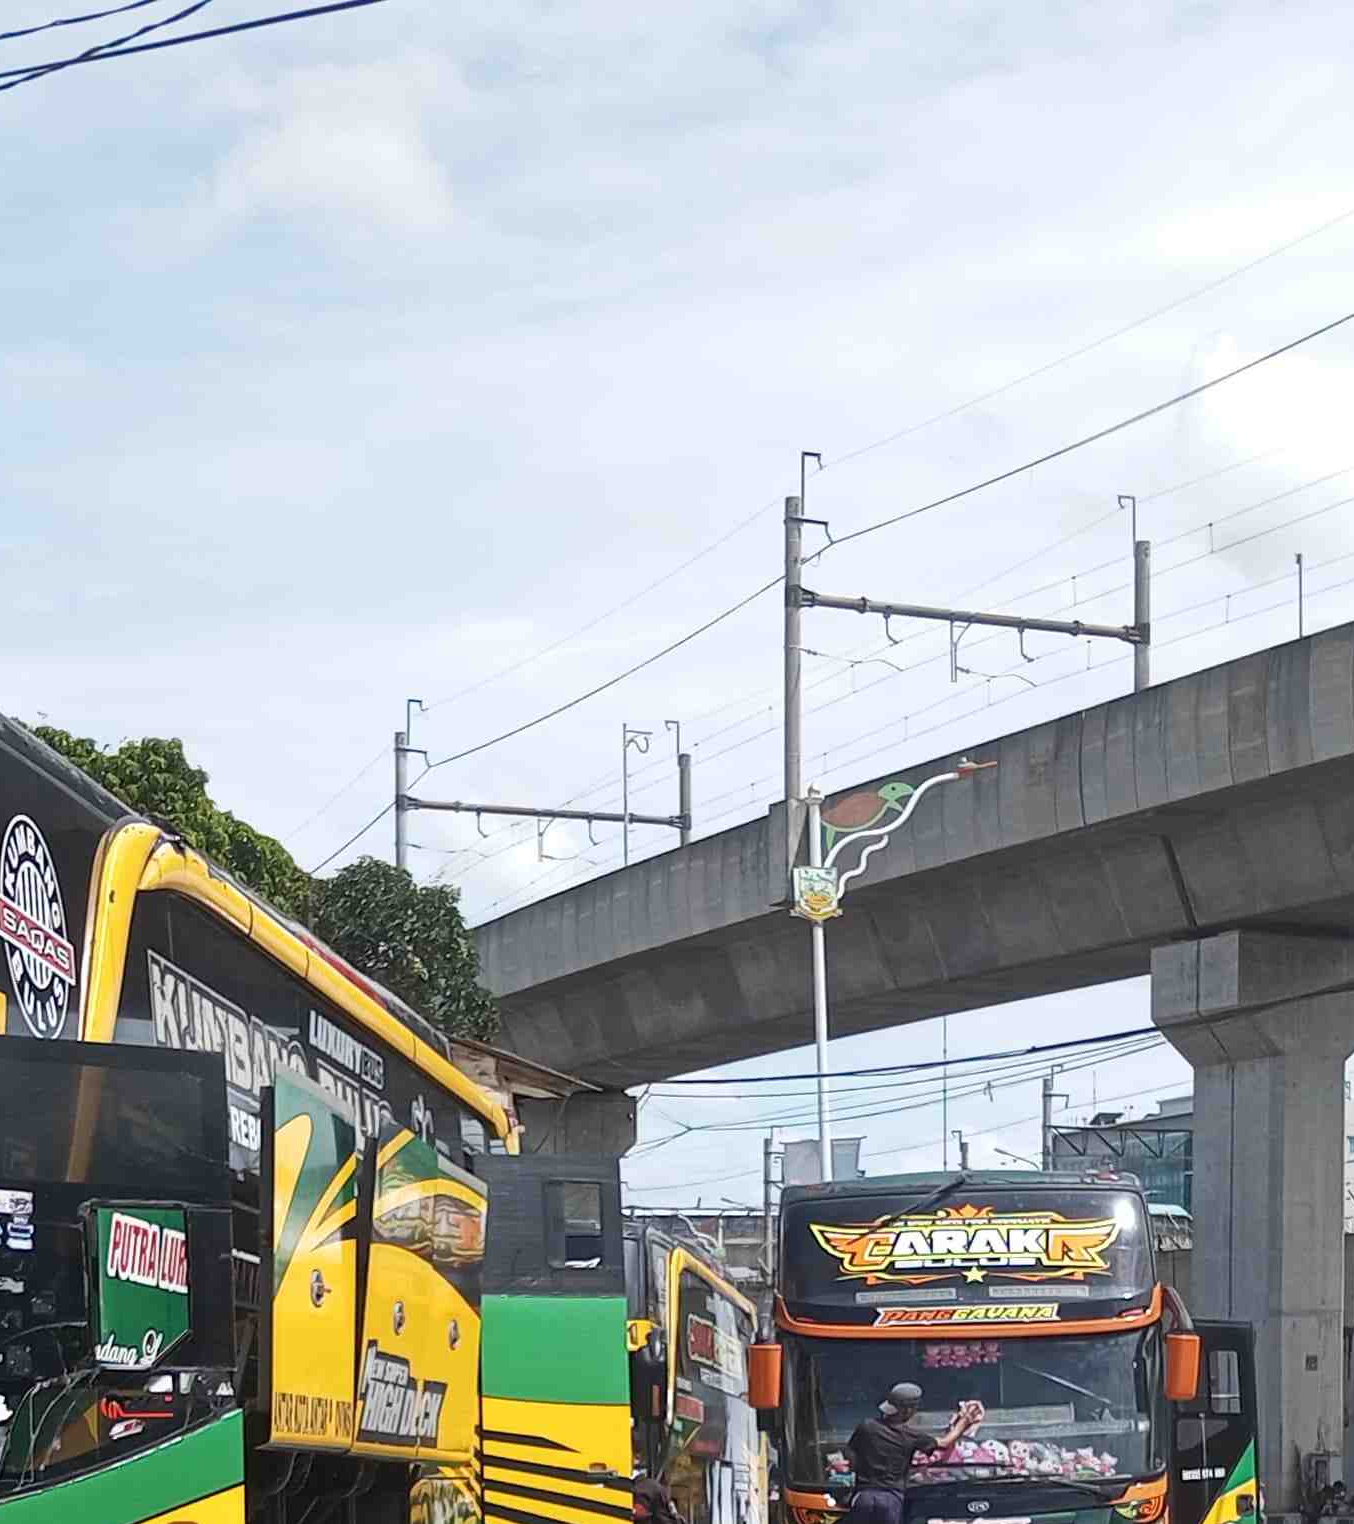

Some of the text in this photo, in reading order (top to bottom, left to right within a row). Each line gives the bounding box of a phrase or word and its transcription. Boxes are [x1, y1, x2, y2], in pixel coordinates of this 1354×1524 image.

[5, 824, 61, 928] KUMBANG
[2, 911, 70, 971] SAQAS
[11, 950, 64, 1031] BULUS
[309, 1010, 363, 1074] LUXURY
[107, 1213, 189, 1293] PUTRA LUR
